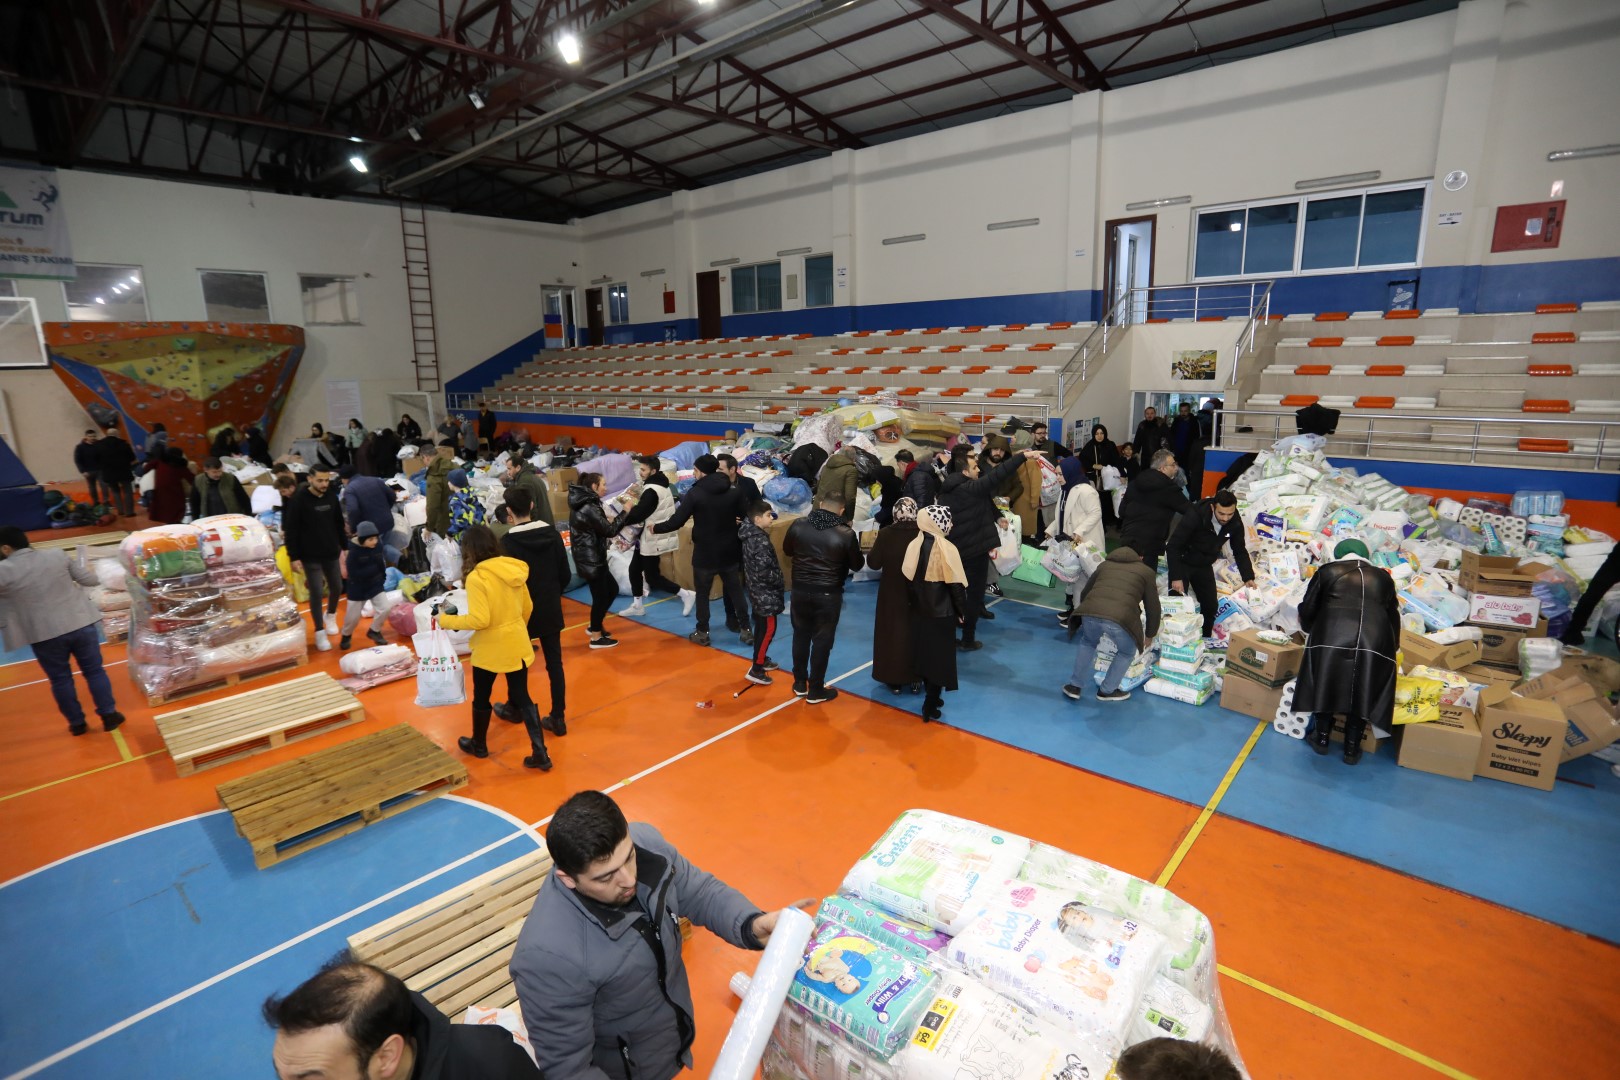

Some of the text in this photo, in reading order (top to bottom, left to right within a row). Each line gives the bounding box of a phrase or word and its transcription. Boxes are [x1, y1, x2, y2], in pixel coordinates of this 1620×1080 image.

[1501, 602, 1523, 613] baby
[1492, 722, 1552, 748] Sleepy
[1491, 752, 1542, 768] Baby Wet Wipes
[987, 910, 1033, 951] baby
[1013, 918, 1043, 953] Baby Diaper
[865, 978, 892, 1006] Baby Diaper
[875, 989, 893, 1007] Willy
[918, 1032, 931, 1044] 64
